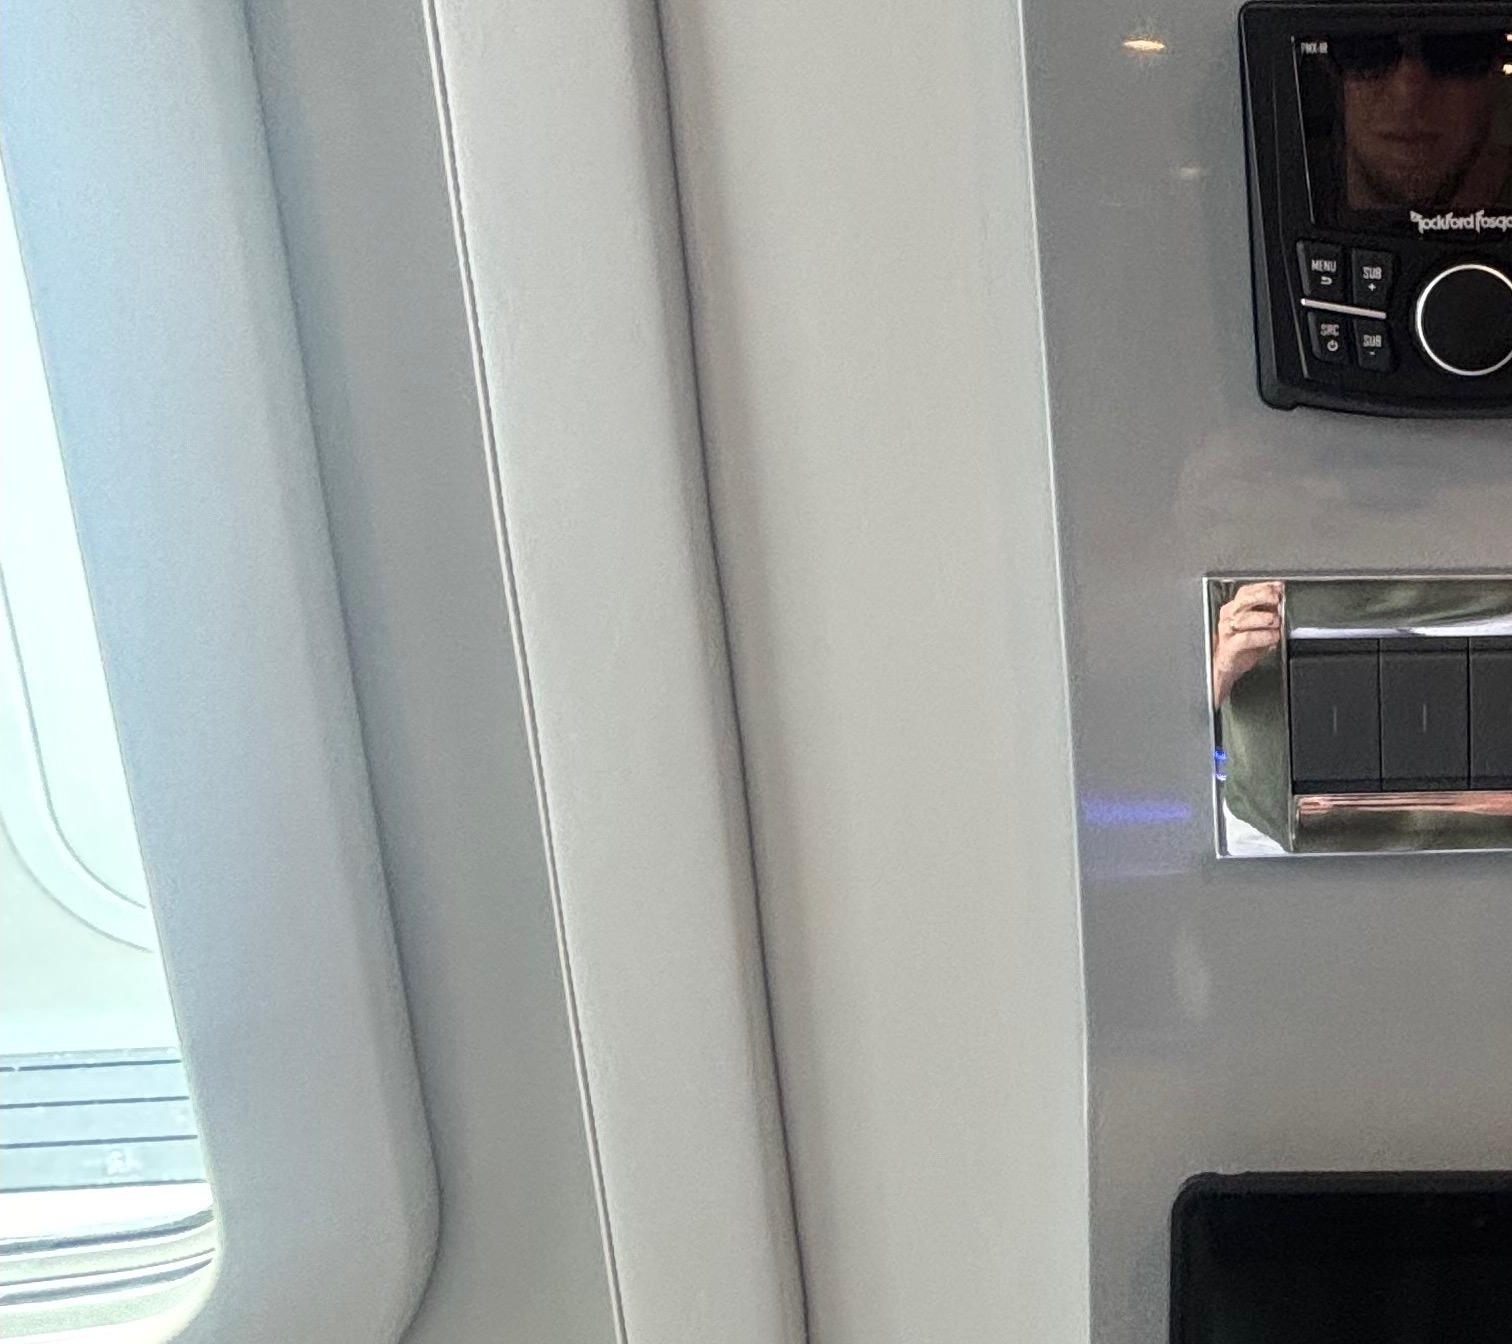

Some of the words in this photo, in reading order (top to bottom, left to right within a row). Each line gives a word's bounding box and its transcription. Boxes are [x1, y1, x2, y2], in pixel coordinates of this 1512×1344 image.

[1311, 259, 1337, 273] MENU
[1362, 266, 1383, 280] SUB
[1362, 334, 1383, 348] SUB
